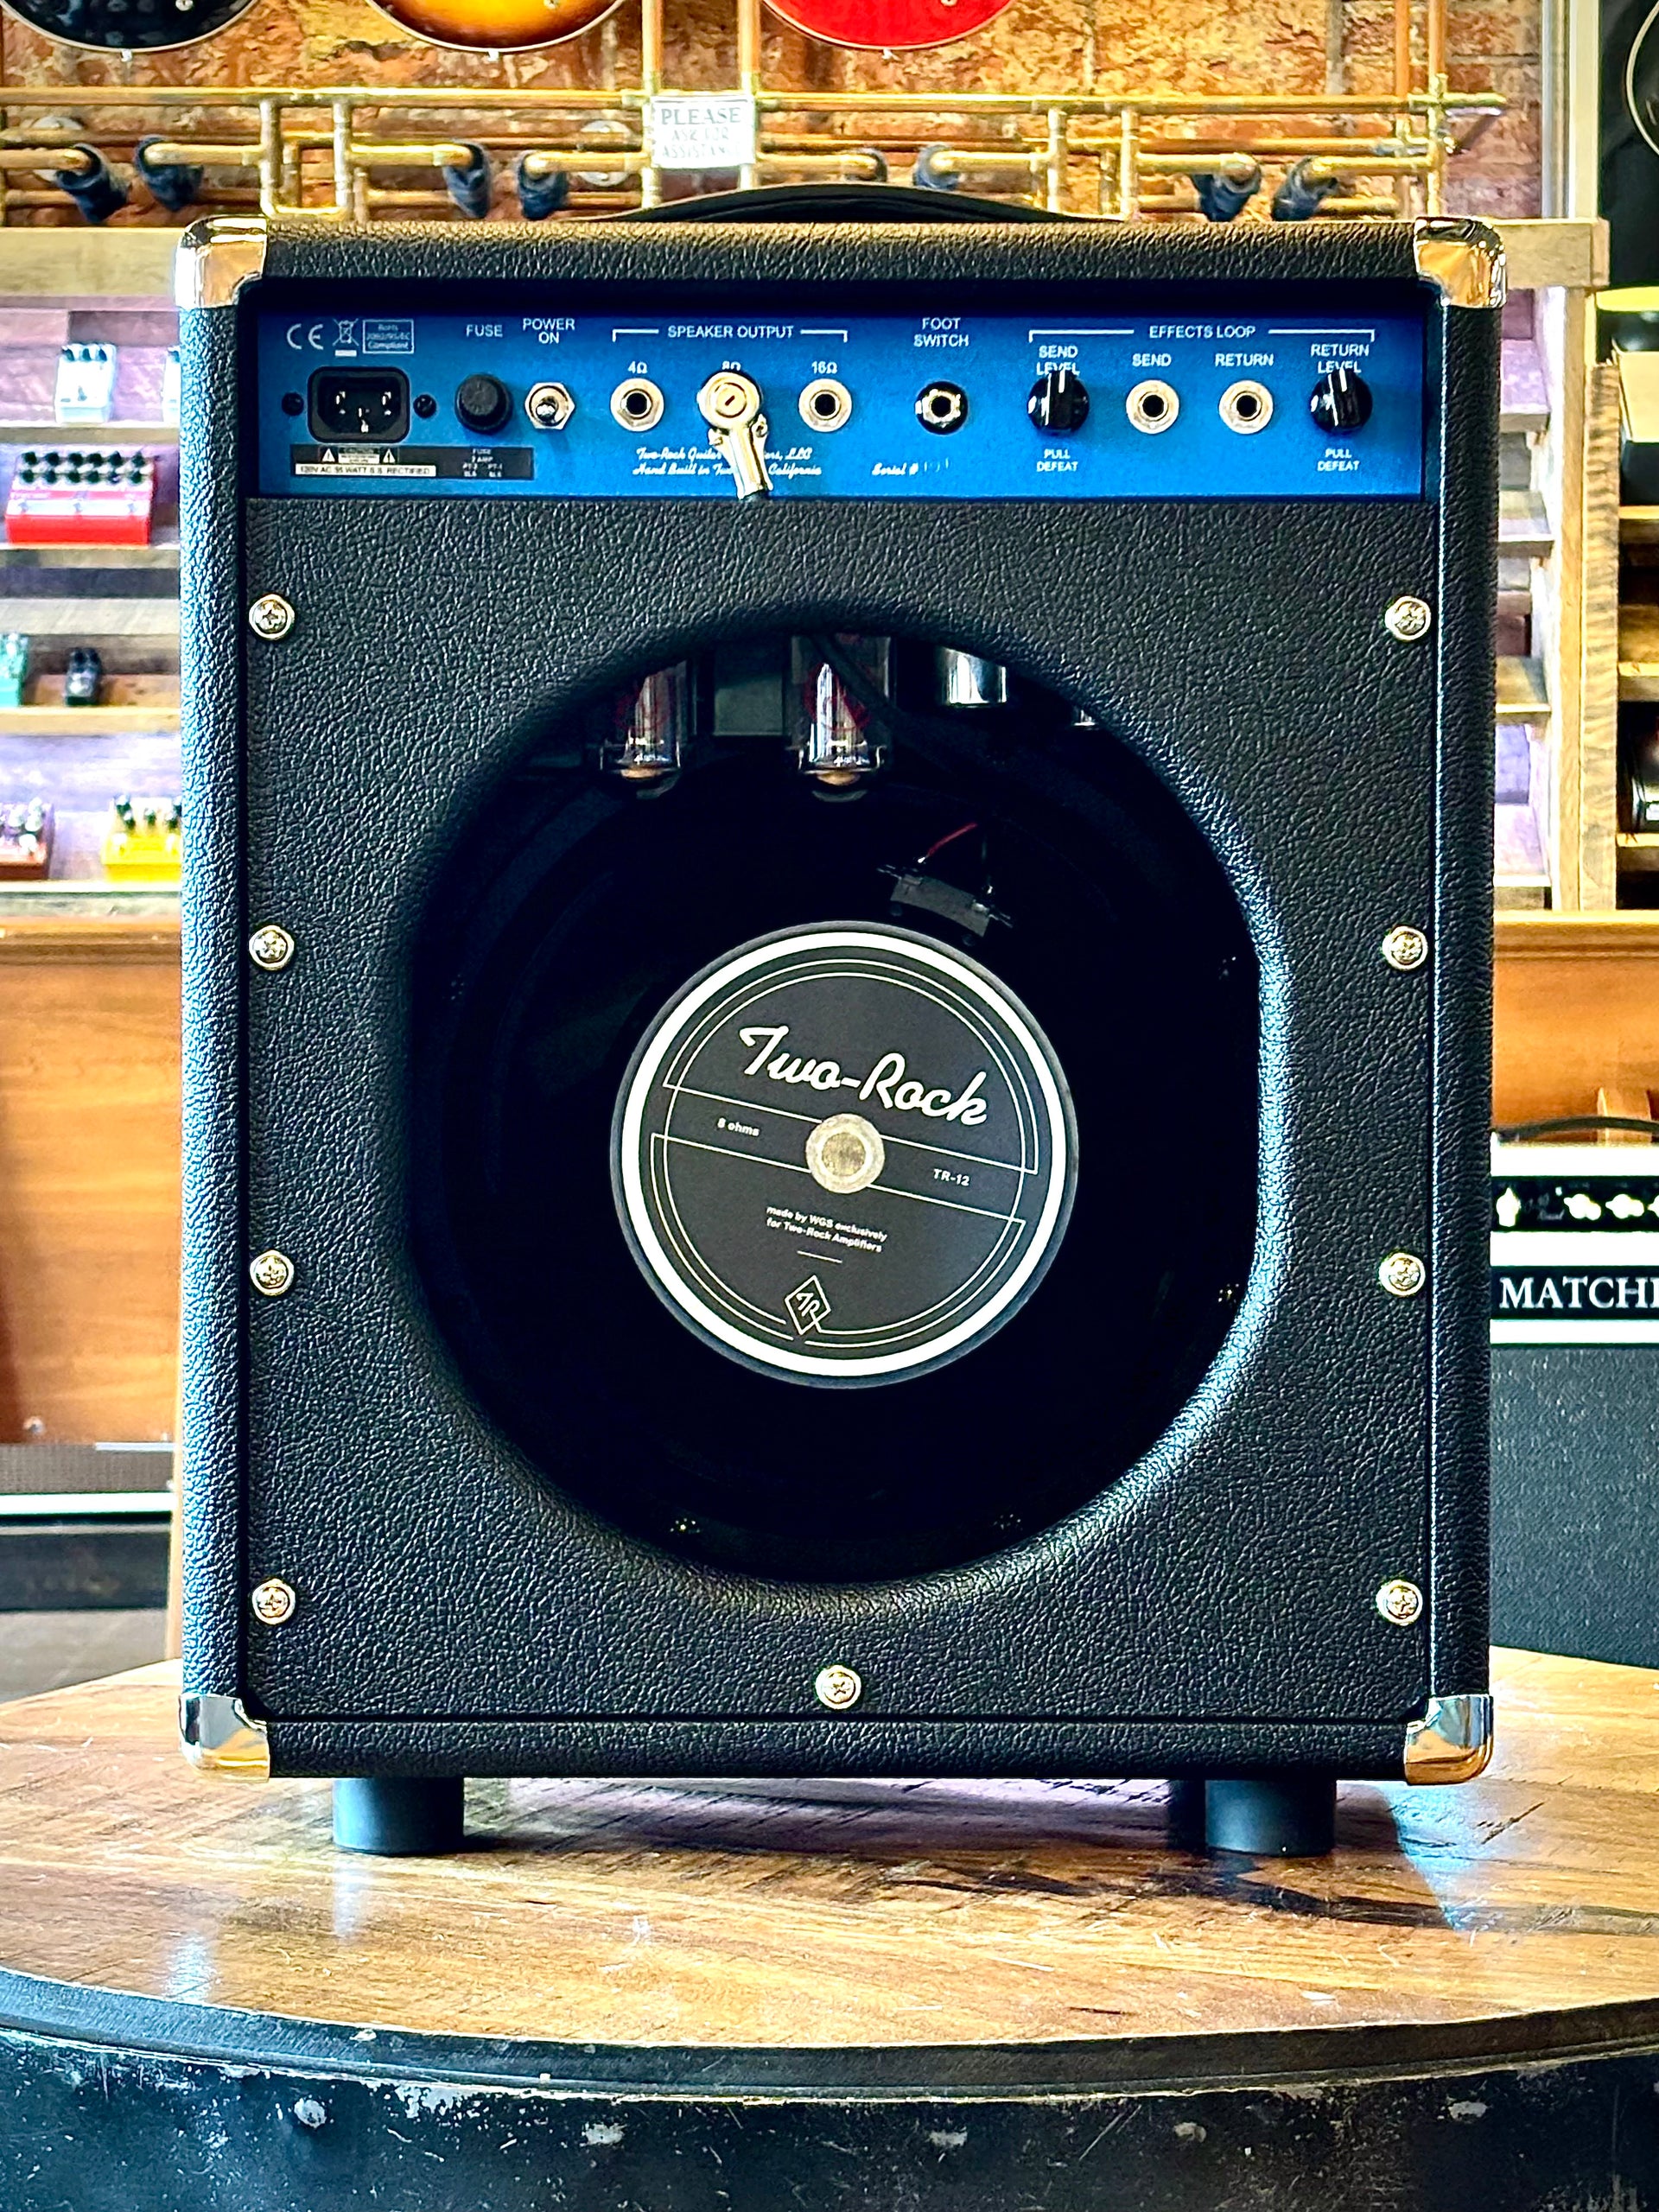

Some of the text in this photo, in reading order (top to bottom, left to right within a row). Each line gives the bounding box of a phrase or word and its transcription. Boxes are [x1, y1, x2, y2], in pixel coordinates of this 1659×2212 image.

[660, 106, 742, 125] PLEASE
[522, 317, 575, 332] POWER
[922, 317, 961, 330] FOOT
[466, 324, 504, 338] FUSE
[667, 325, 794, 339] SPEAKER OUTPUT
[1148, 325, 1256, 339] EFFECTS LOOP
[538, 332, 560, 345] ON
[913, 334, 969, 347] SWITCH
[1039, 345, 1078, 359] SEND
[1310, 343, 1370, 357] RETURN
[1132, 353, 1172, 367] SEND
[1215, 353, 1274, 367] RETURN
[627, 361, 648, 374] 4Ω
[810, 361, 838, 374] 16Ω
[1044, 448, 1071, 460] PULL
[1325, 448, 1352, 459] PULL
[768, 462, 823, 480] California
[871, 462, 907, 476] Serial
[1036, 461, 1078, 473] DEFEAT
[1317, 461, 1360, 472] DEFEAT
[738, 1025, 988, 1126] Two-Rock
[728, 1120, 760, 1137] ohms
[932, 1167, 971, 1187] TR-12
[766, 1206, 888, 1243] made by WGS exclusively
[766, 1217, 883, 1253] for Two-Rock Amplifiers
